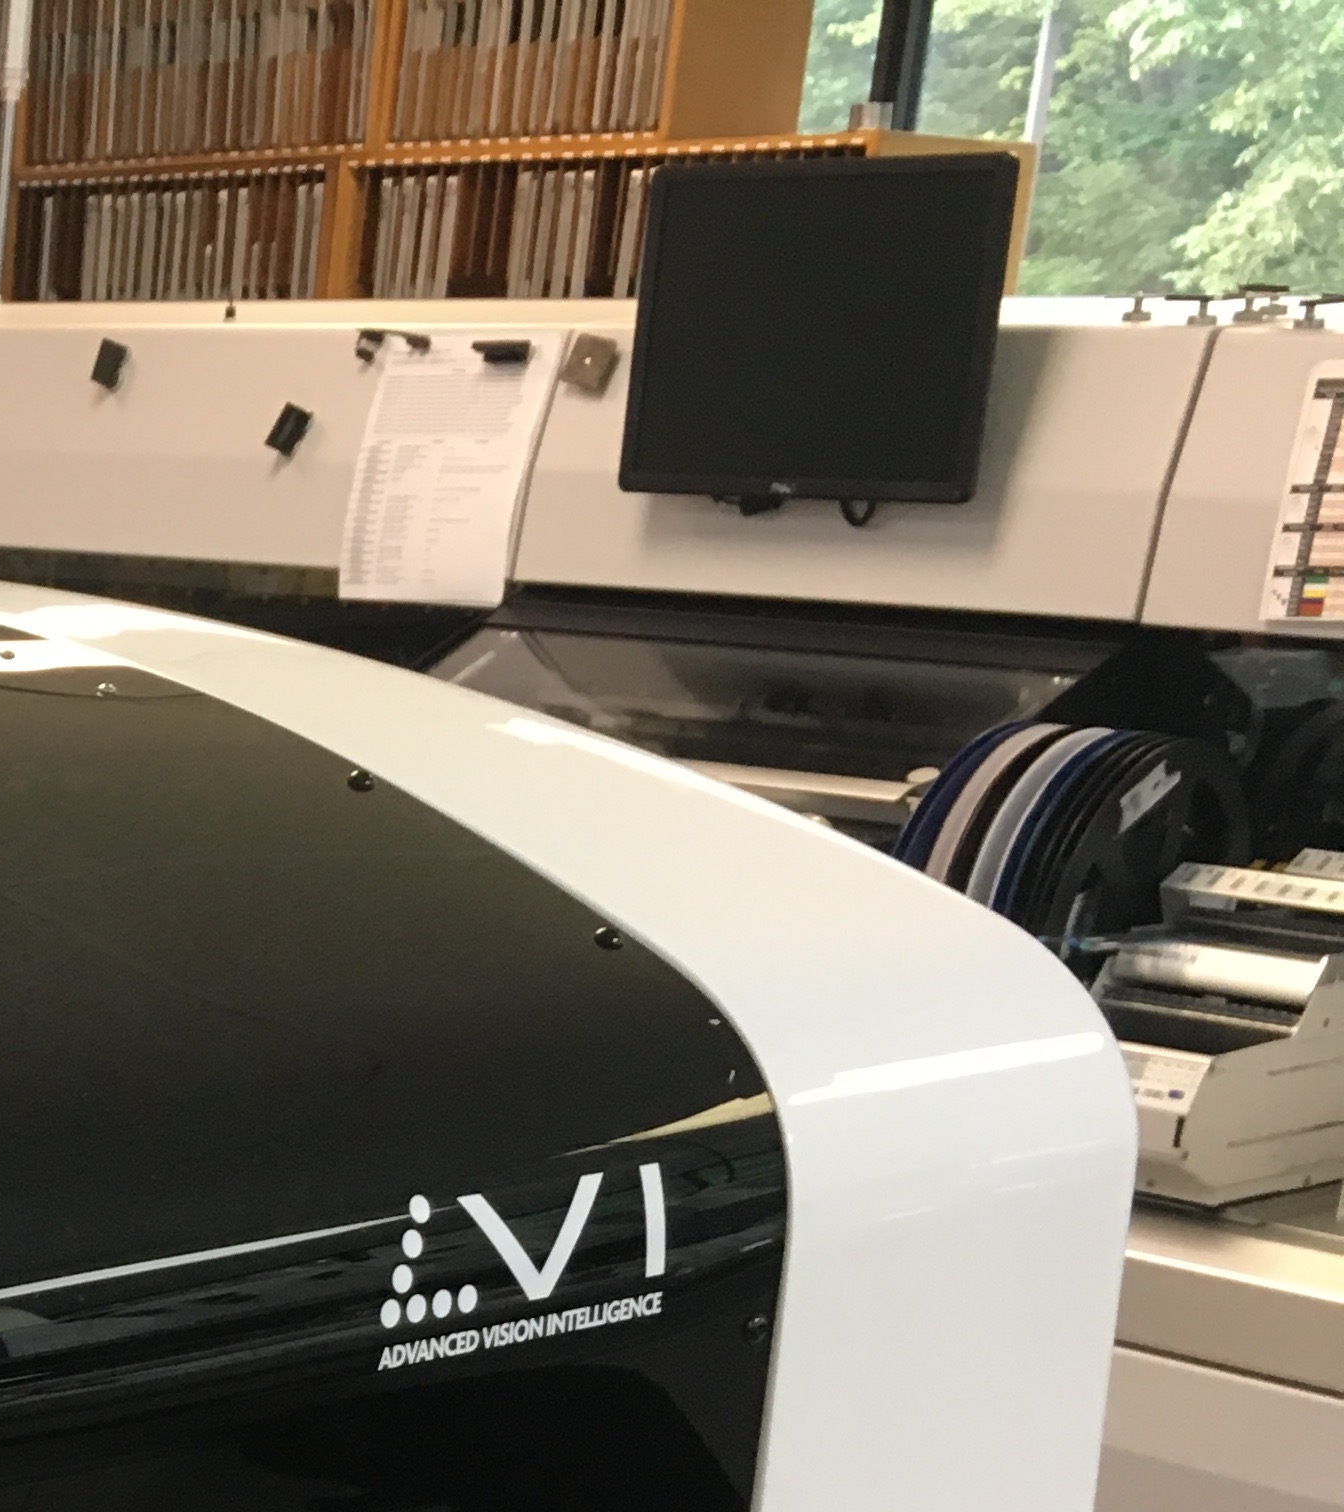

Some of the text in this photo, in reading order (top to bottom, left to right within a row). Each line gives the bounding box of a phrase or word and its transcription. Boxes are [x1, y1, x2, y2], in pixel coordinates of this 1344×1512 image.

[377, 1291, 664, 1371] ADVANCED VISION INTELLIGENCE
